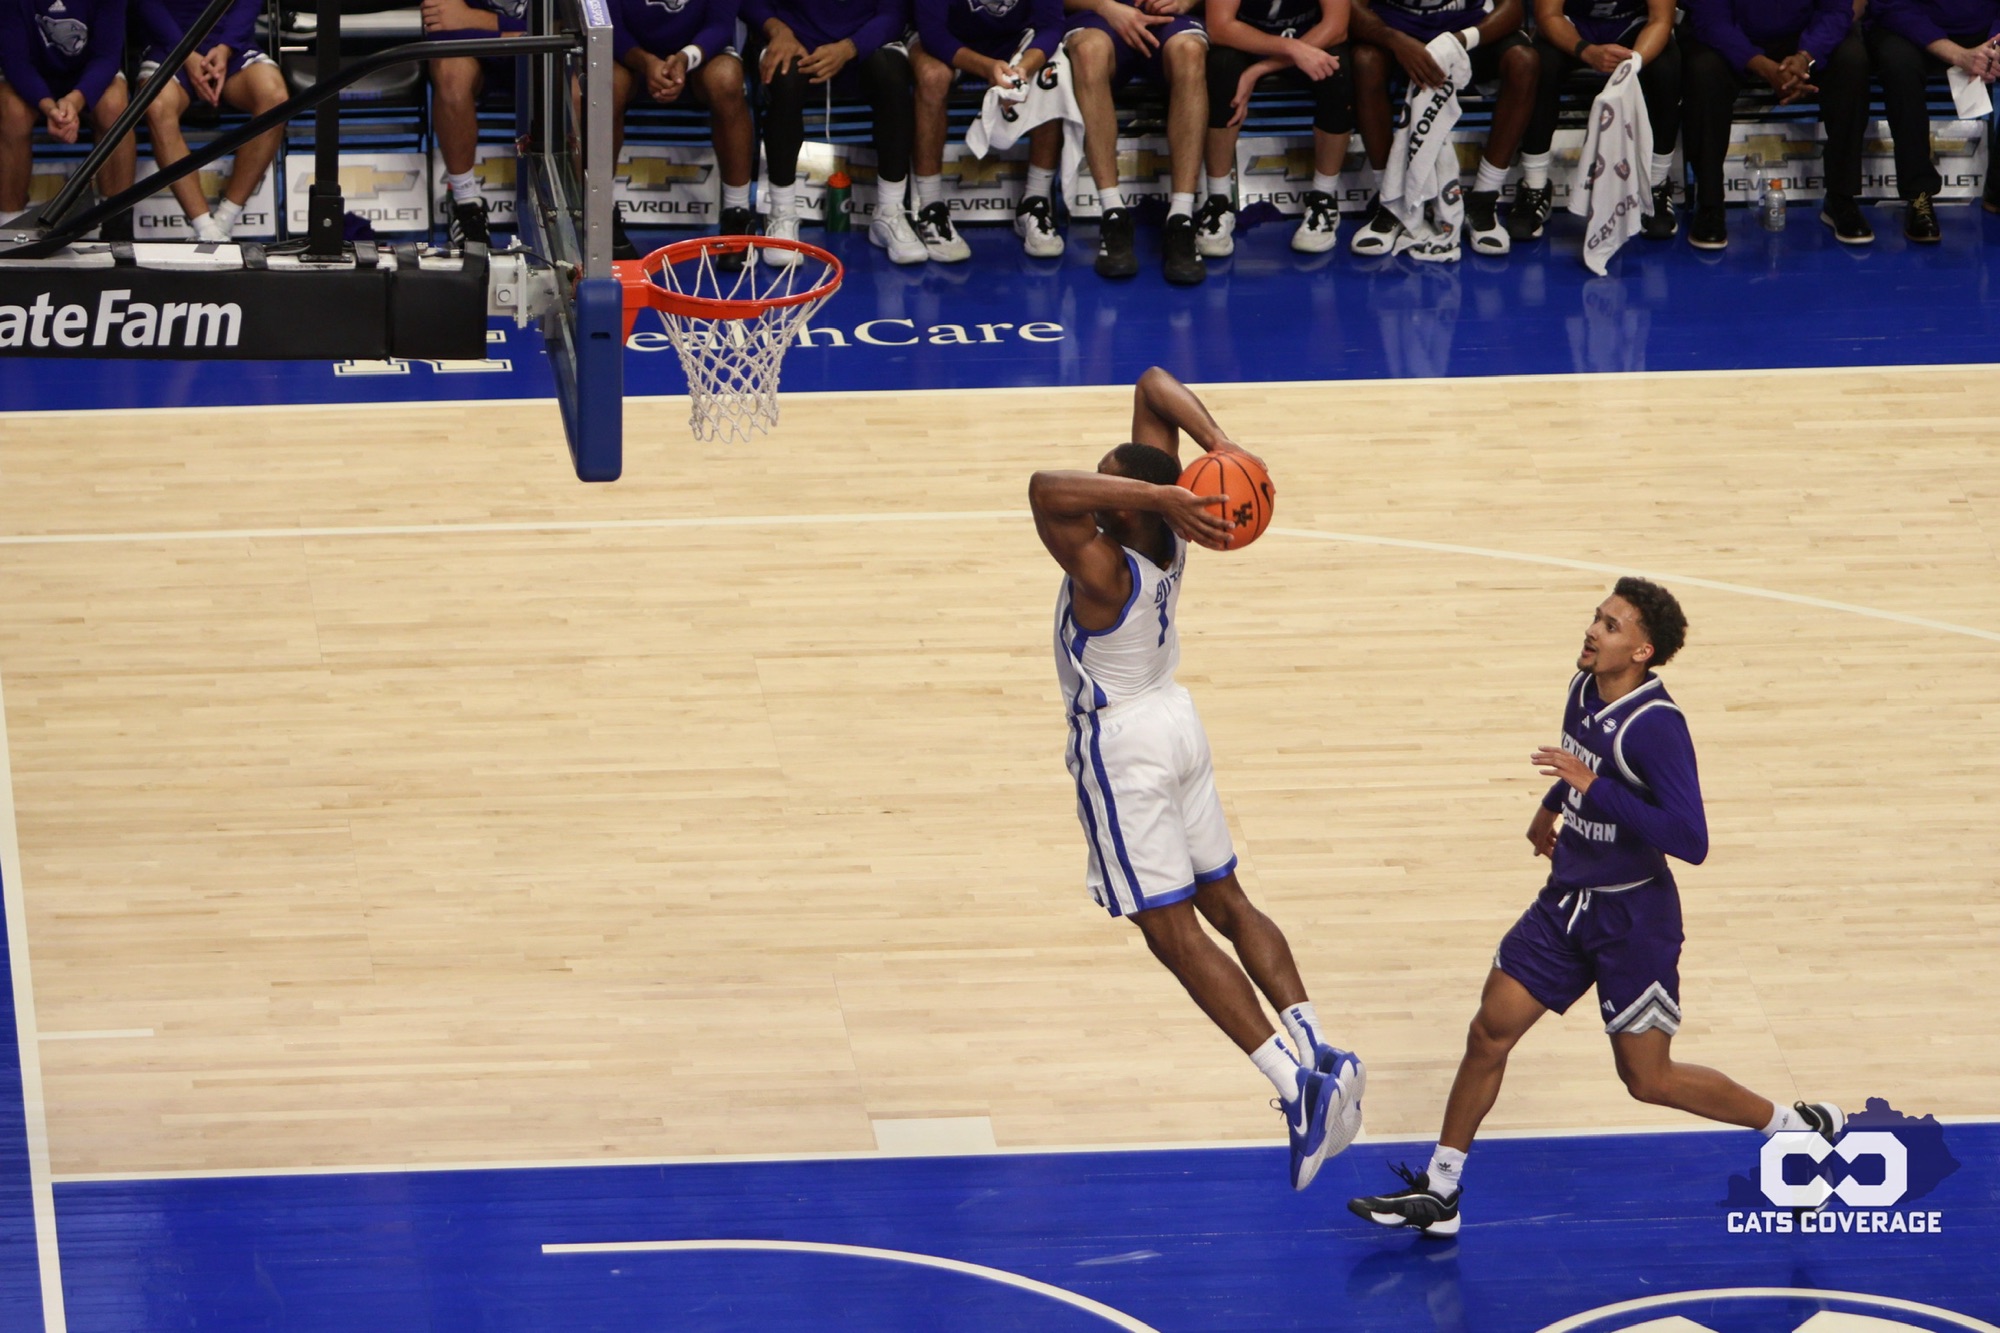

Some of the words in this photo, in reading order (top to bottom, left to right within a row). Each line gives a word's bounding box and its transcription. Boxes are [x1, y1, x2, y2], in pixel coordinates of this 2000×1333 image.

[1246, 188, 1372, 204] CHEVLET
[615, 200, 713, 214] EVROLET
[625, 316, 1066, 352] ealthCare
